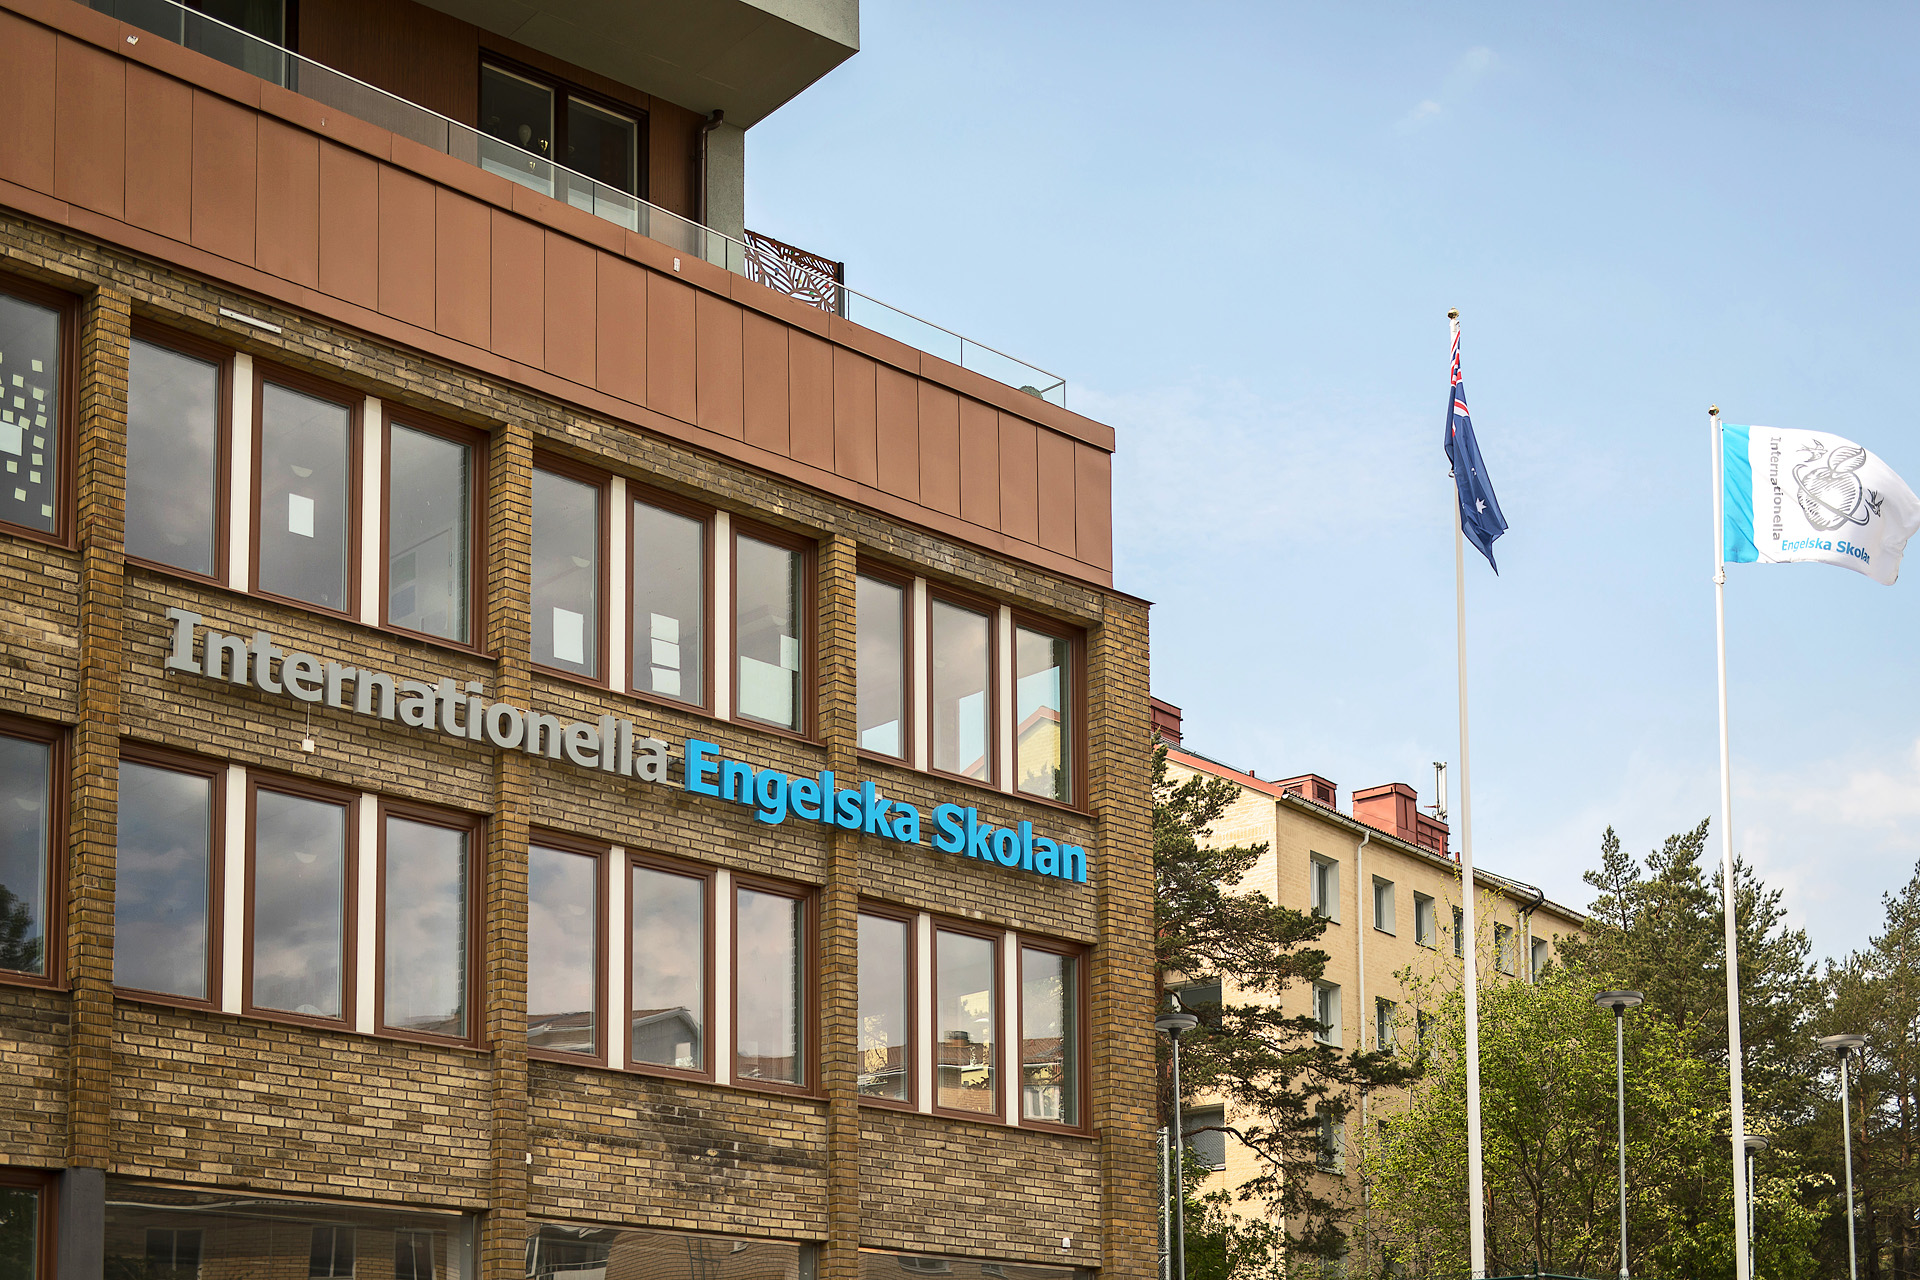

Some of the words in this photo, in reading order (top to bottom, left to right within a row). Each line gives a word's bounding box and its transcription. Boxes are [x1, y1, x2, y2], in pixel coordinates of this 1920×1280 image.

[1770, 437, 1784, 541] Internationella
[1781, 537, 1832, 552] Engelska
[165, 607, 668, 784] Internationella
[685, 738, 920, 844] Engelska
[932, 803, 1088, 883] Skolan
